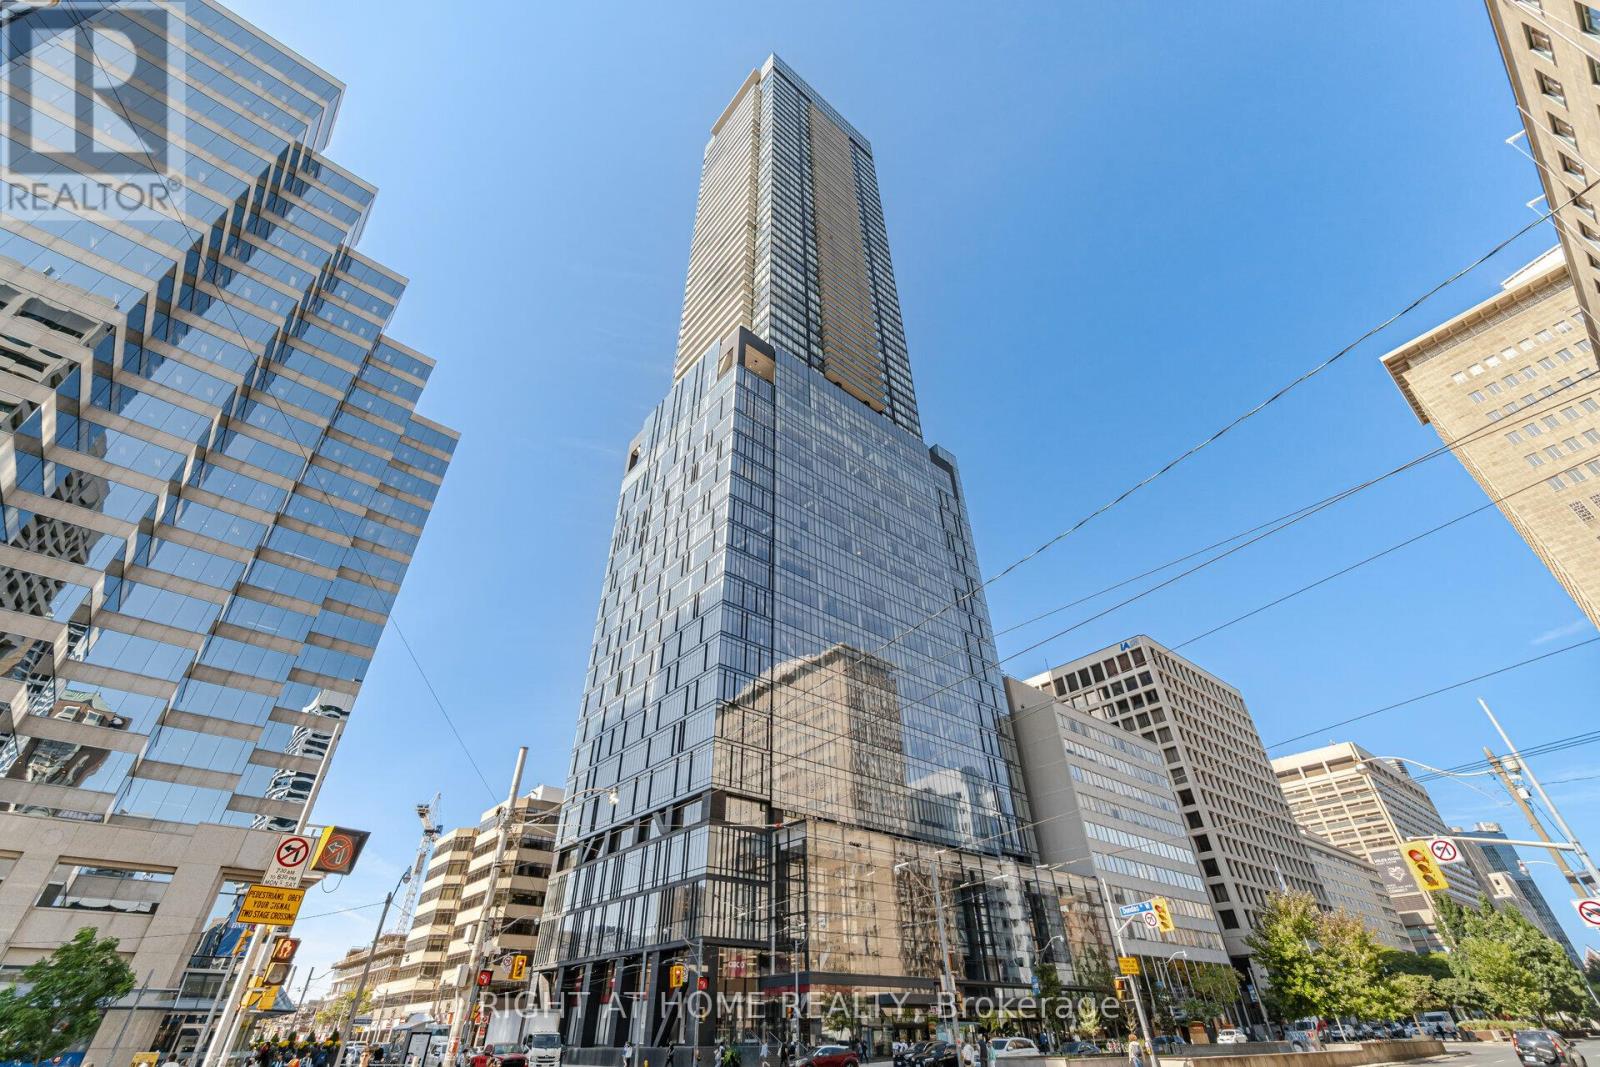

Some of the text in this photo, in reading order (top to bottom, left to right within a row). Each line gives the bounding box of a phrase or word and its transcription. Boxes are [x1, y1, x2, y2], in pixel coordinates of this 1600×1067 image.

[248, 890, 303, 902] PEDESTRIANS OBEY
[253, 901, 291, 910] YOUR SIGNAL
[241, 909, 296, 921] TWO STAGE CROSSING
